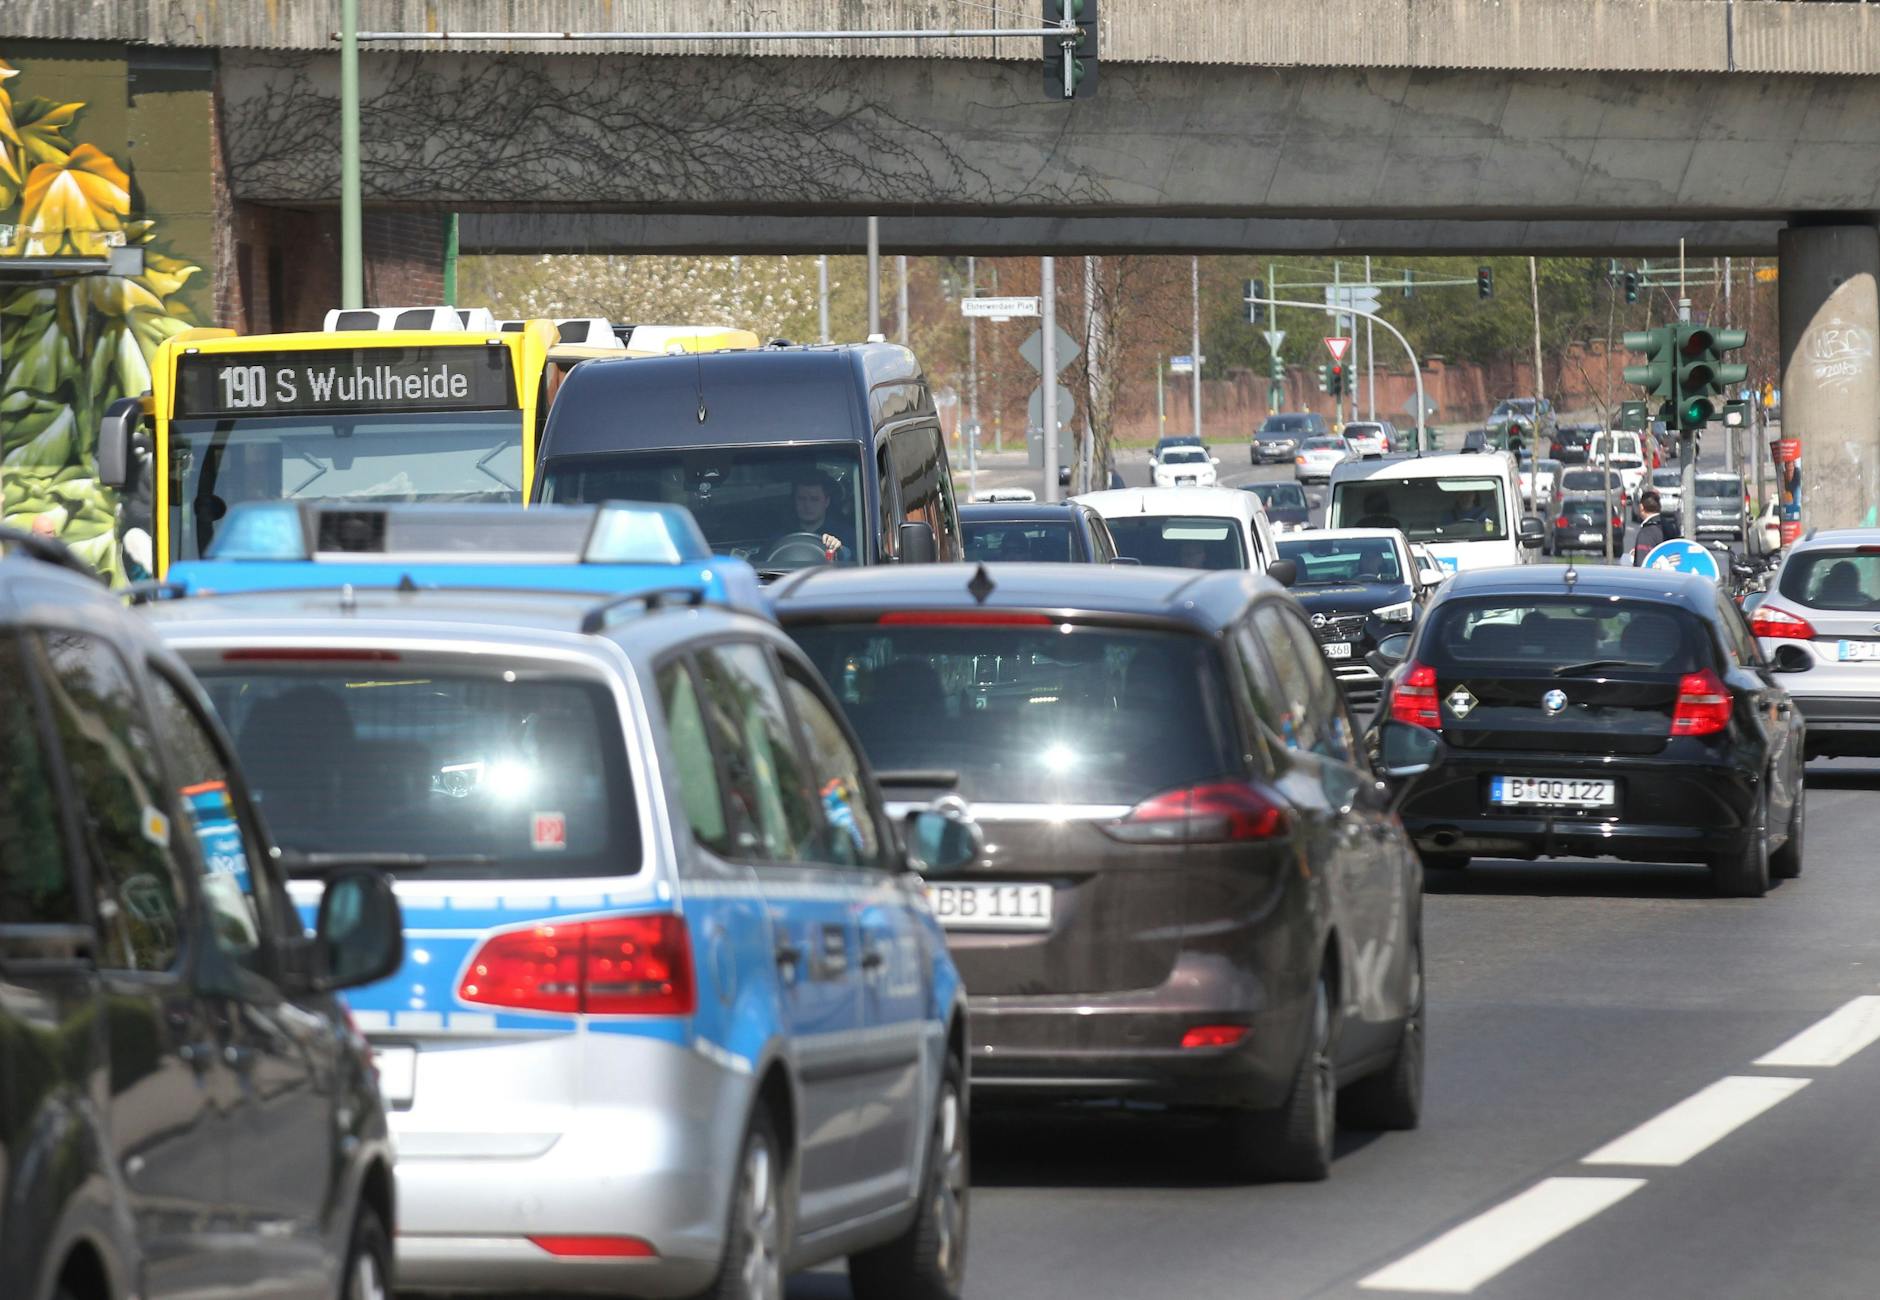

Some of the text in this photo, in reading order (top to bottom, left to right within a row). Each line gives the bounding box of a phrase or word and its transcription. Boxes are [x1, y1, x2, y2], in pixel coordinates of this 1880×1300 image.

[219, 364, 468, 408] 190 S Wuhlheide
[1849, 643, 1858, 657] B
[1512, 780, 1605, 800] B QQ 122
[938, 887, 1044, 917] BB 111
